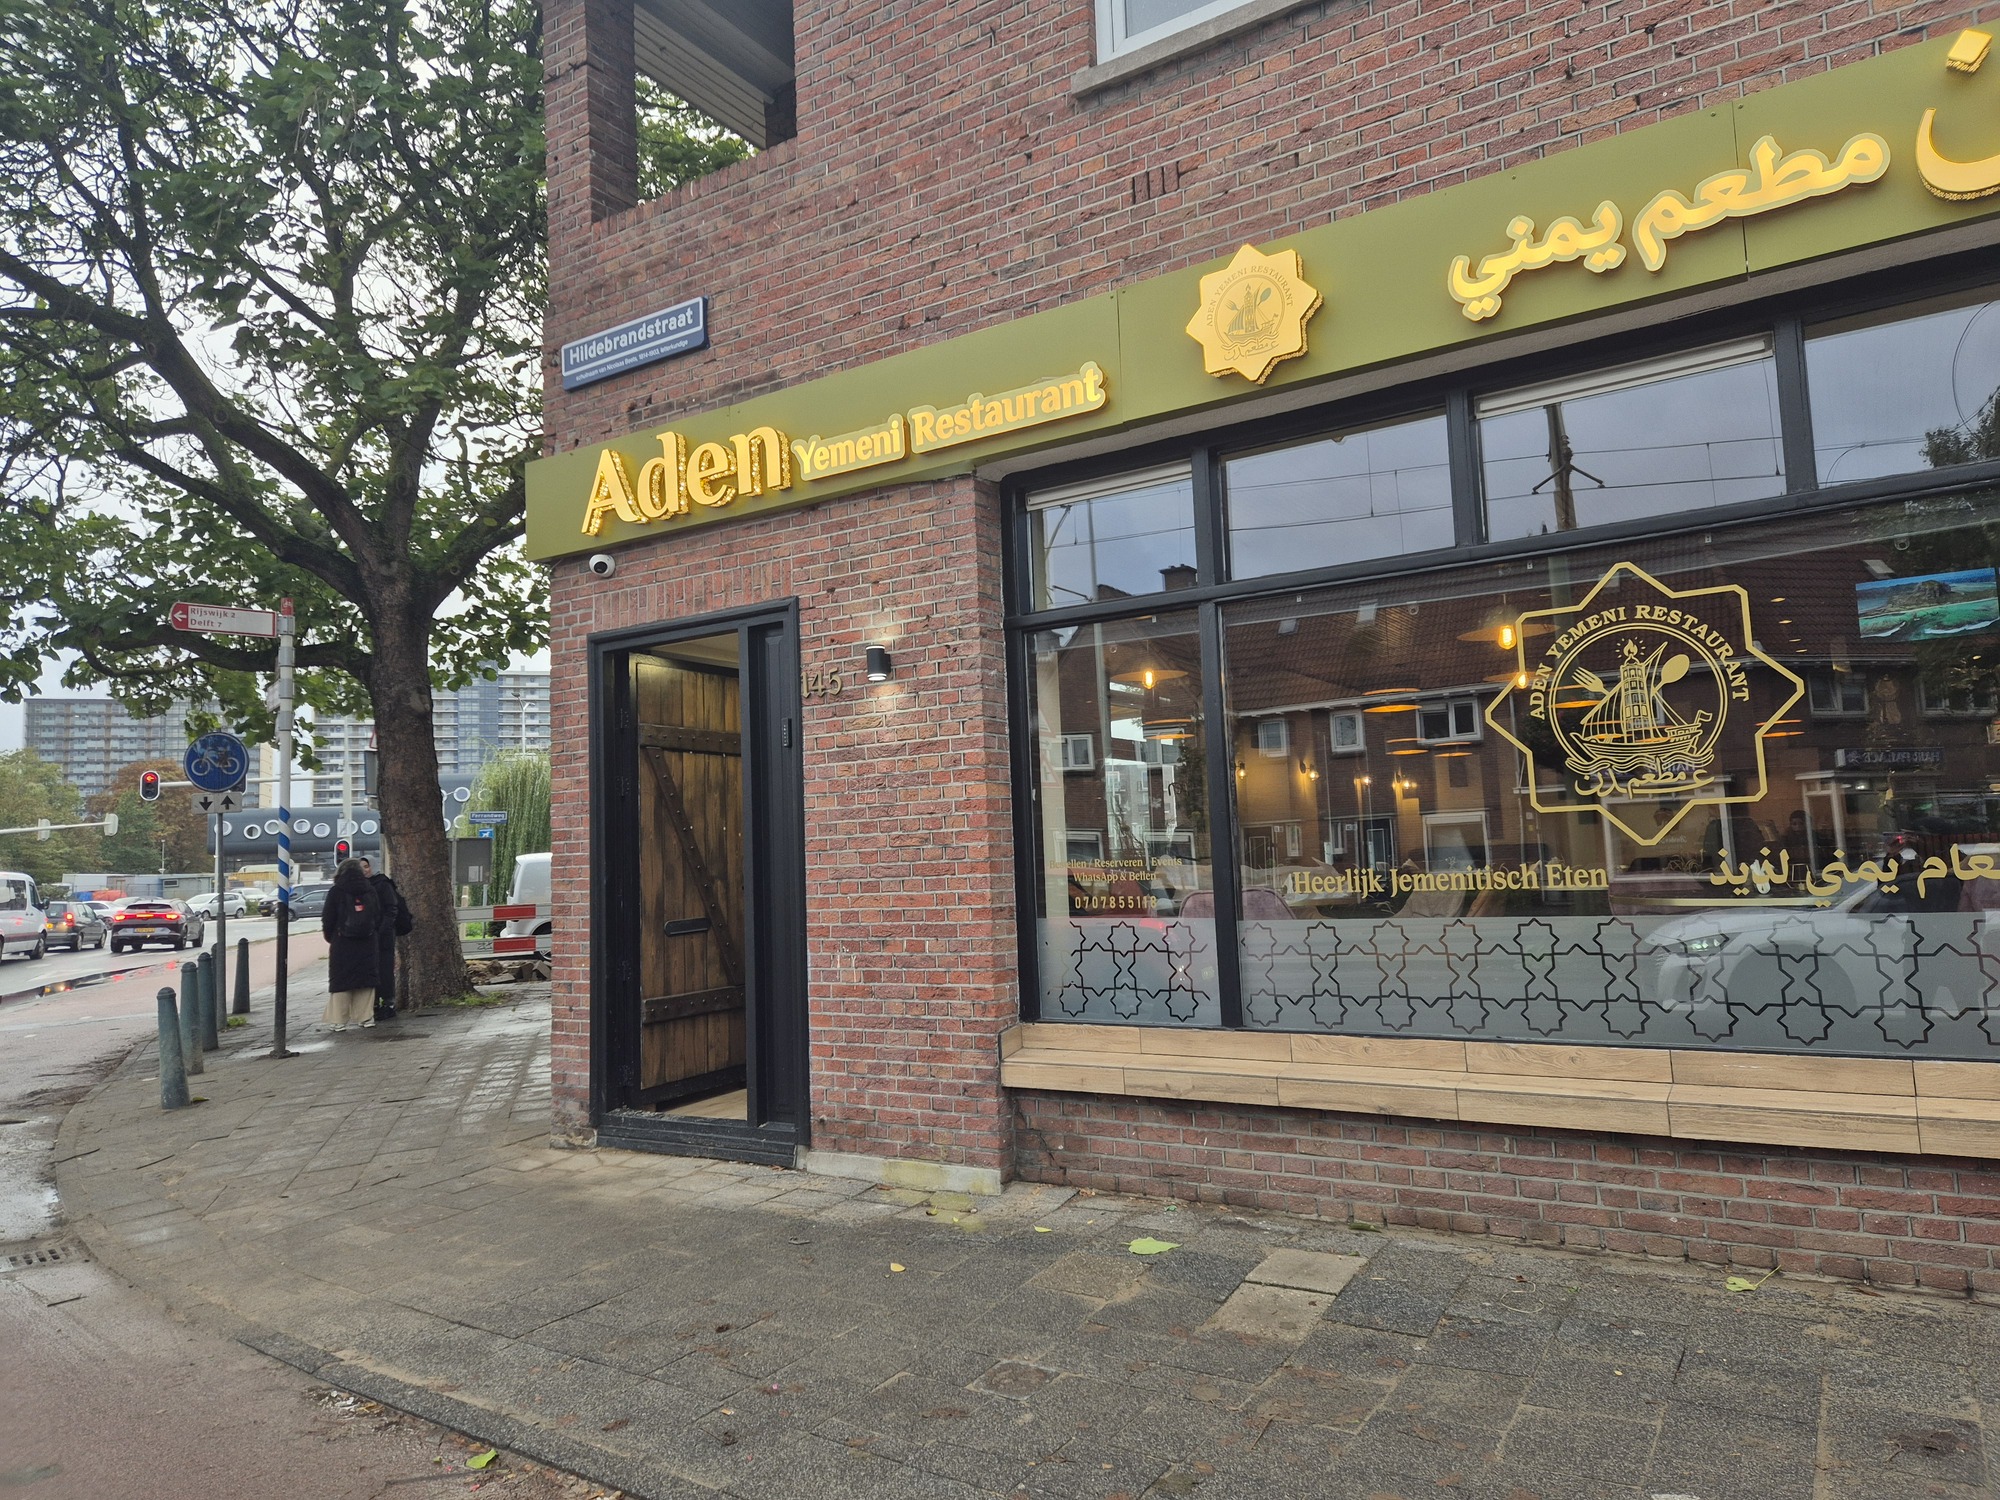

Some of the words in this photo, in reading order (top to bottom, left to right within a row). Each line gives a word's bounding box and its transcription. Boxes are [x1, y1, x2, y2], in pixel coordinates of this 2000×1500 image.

[1636, 136, 1888, 270] مطعم
[1450, 203, 1622, 320] يمني
[1206, 300, 1216, 327] ADEN
[1215, 267, 1248, 297] YEMENI
[1250, 265, 1294, 307] RESTAURANT
[569, 307, 693, 365] Hildebrandstraat
[580, 426, 792, 536] Aden
[794, 415, 903, 475] Yemeni
[911, 366, 1104, 446] Restaurant
[190, 607, 228, 618] Rijswijk
[190, 619, 215, 627] Delft
[801, 667, 842, 698] 145
[1529, 662, 1554, 720] ADEN
[1546, 605, 1628, 660] YEMENI
[1634, 604, 1750, 703] RESTAURANT
[1073, 872, 1119, 883] WhatsApp
[1119, 872, 1127, 881] &
[1129, 871, 1157, 881] Bellen
[1094, 858, 1143, 868] Reserveren
[1151, 856, 1182, 867] Events
[1292, 867, 1384, 899] Heerlijk
[1389, 863, 1540, 898] Jemenitisch
[1546, 863, 1609, 889] Eten
[1709, 846, 1790, 896] لذيذ
[1806, 848, 1899, 908] يمني
[1917, 842, 2000, 898] عام
[1074, 895, 1157, 909] 0707855118
